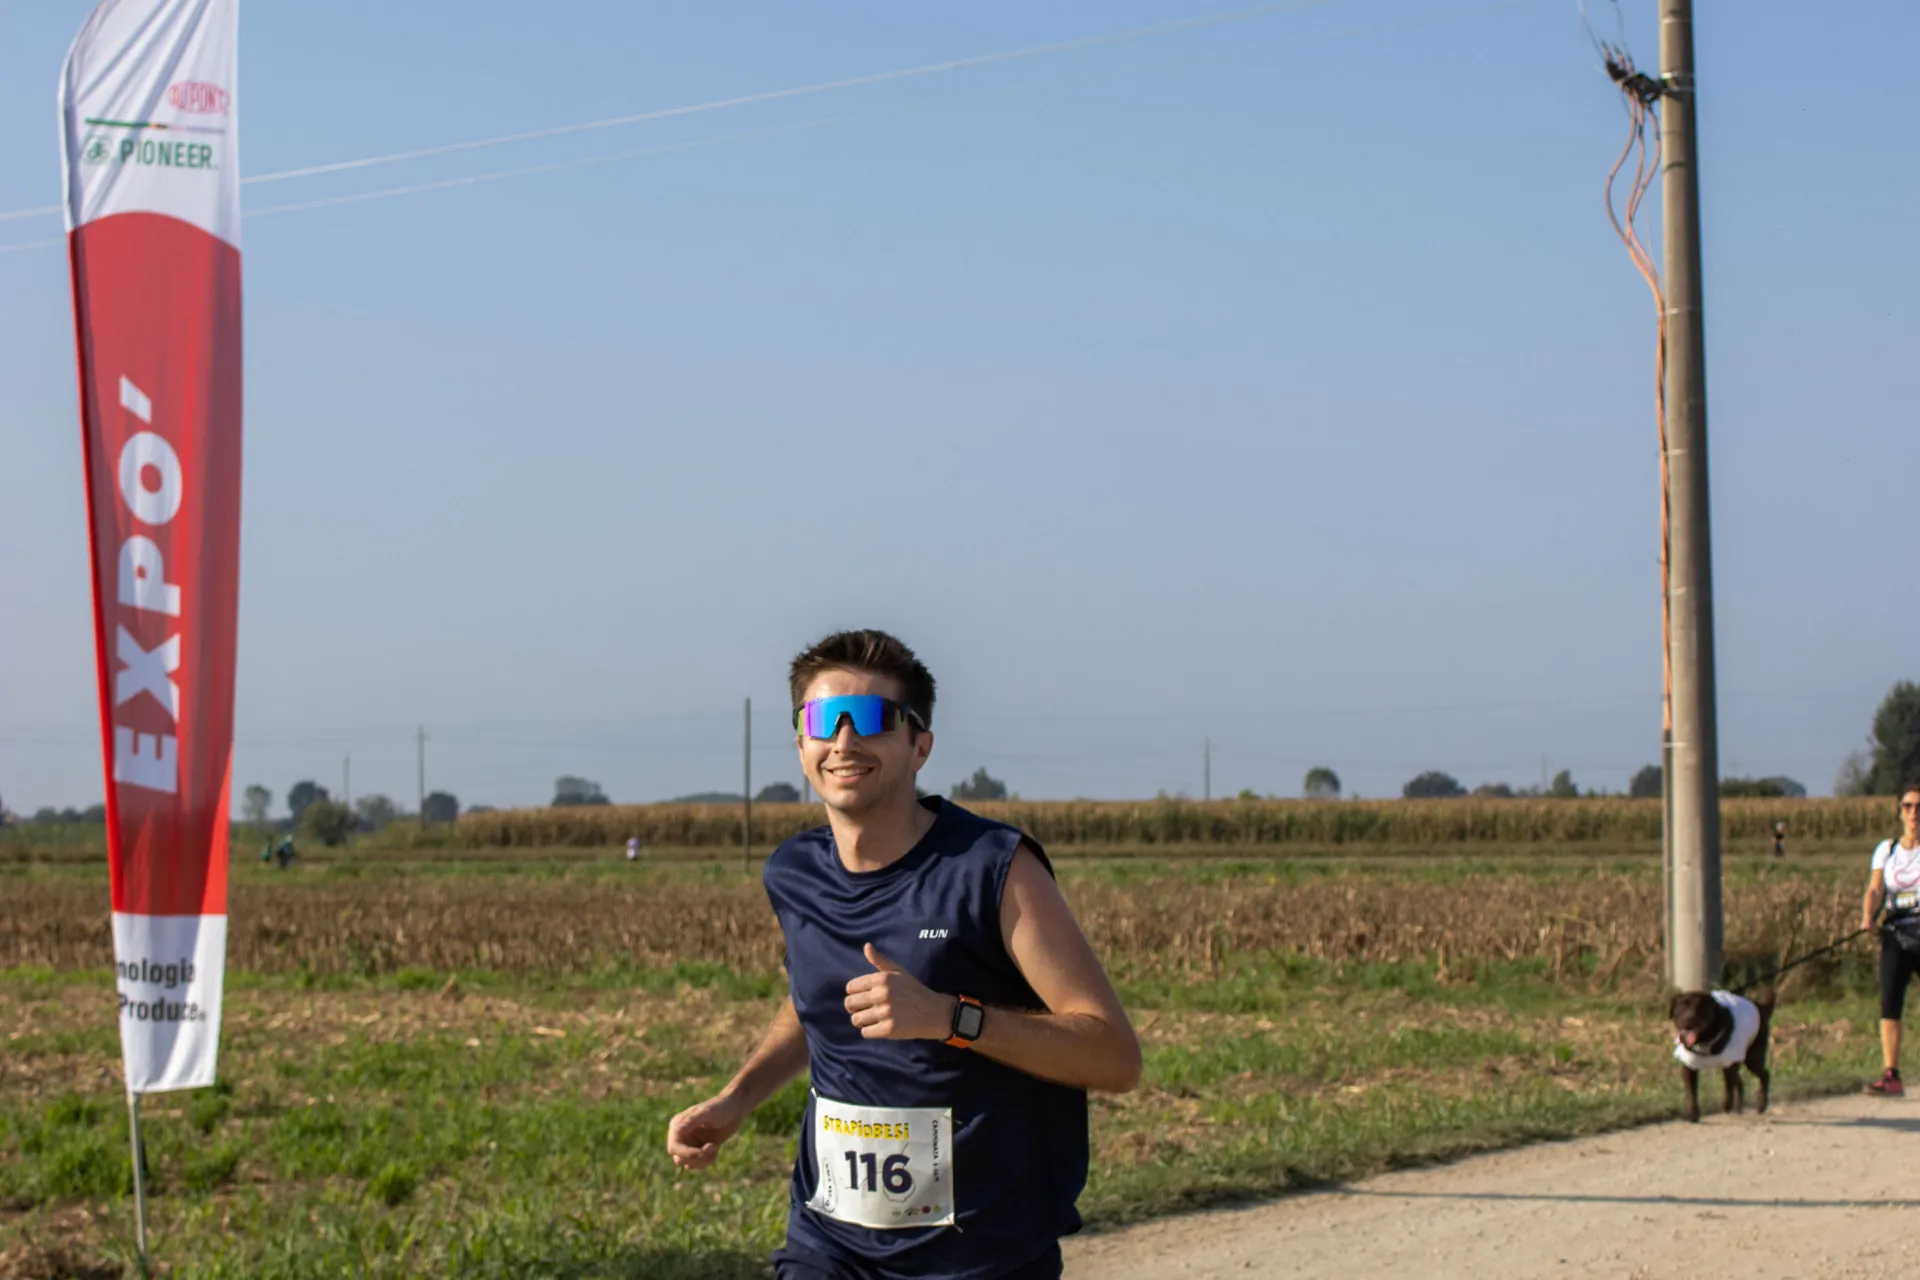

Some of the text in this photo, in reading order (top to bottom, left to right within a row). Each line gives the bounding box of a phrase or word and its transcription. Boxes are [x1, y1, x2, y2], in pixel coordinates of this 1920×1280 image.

[120, 139, 213, 170] PIONEER
[918, 928, 949, 940] RUN
[844, 1150, 913, 1194] 116
